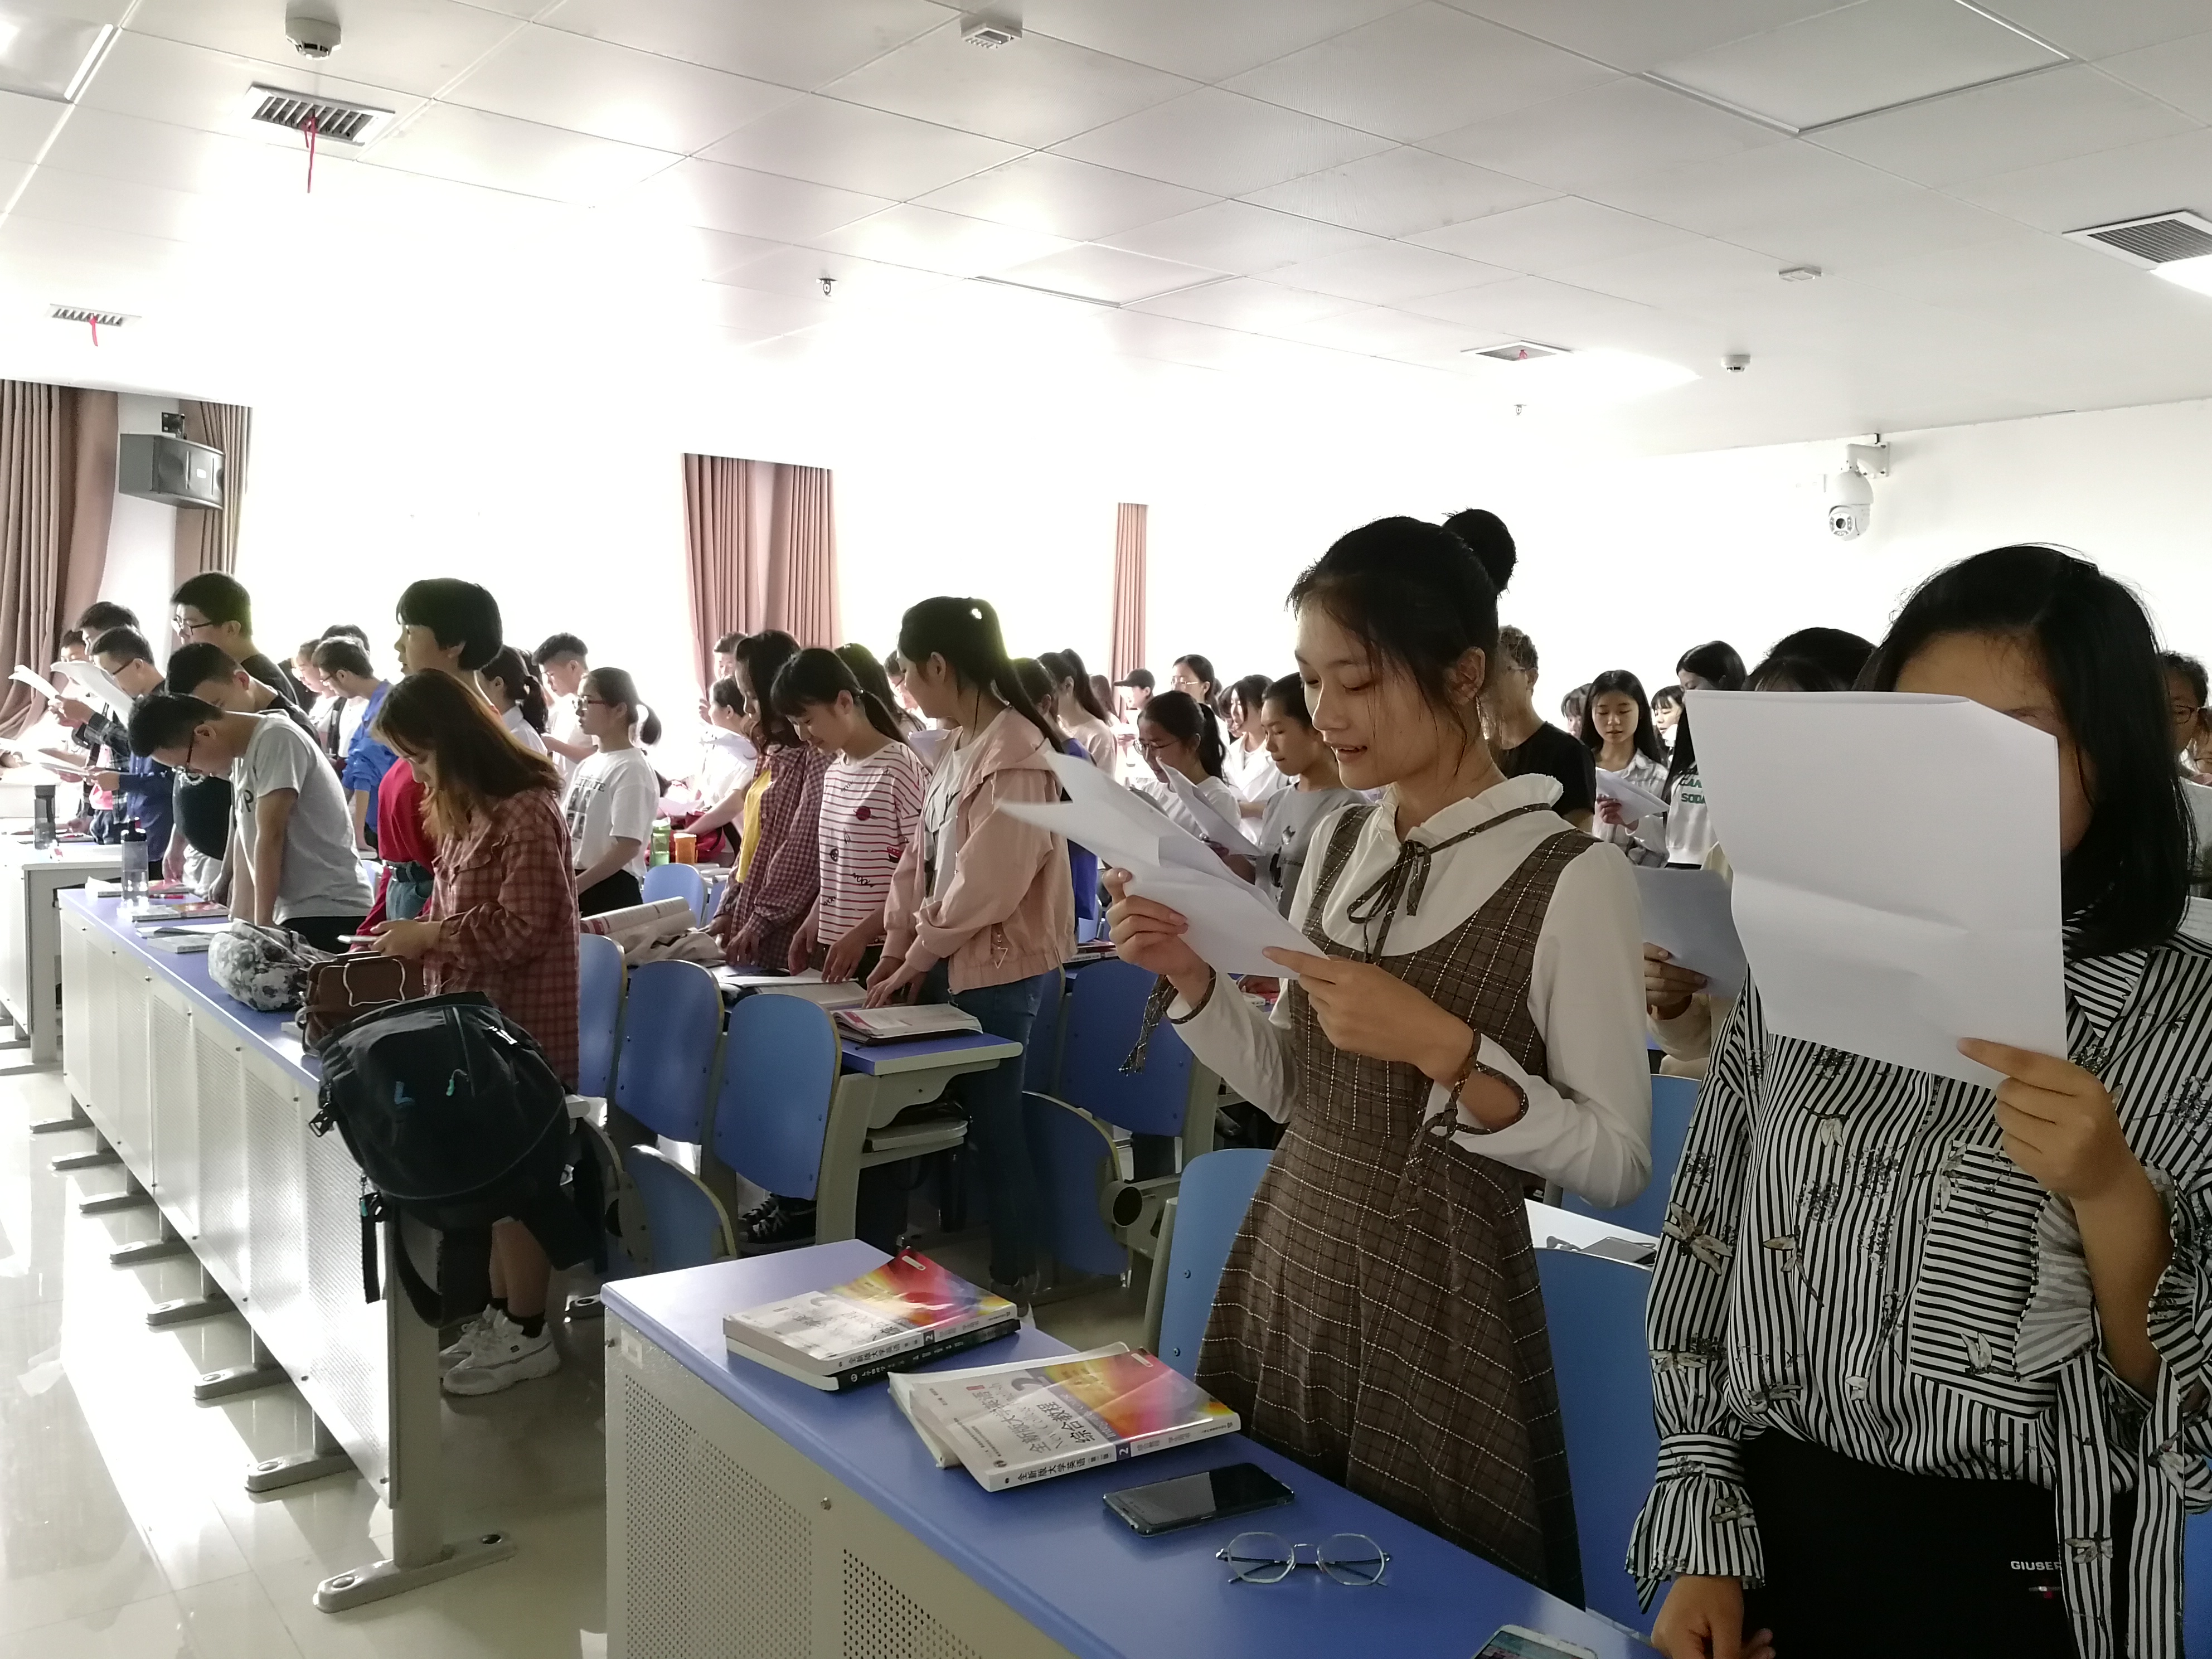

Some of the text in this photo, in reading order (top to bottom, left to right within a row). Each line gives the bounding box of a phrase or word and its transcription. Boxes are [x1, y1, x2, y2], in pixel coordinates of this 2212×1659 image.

[1011, 1376, 1052, 1391] 2
[1036, 1401, 1096, 1443] 综合教程
[1119, 1447, 1129, 1456] 2
